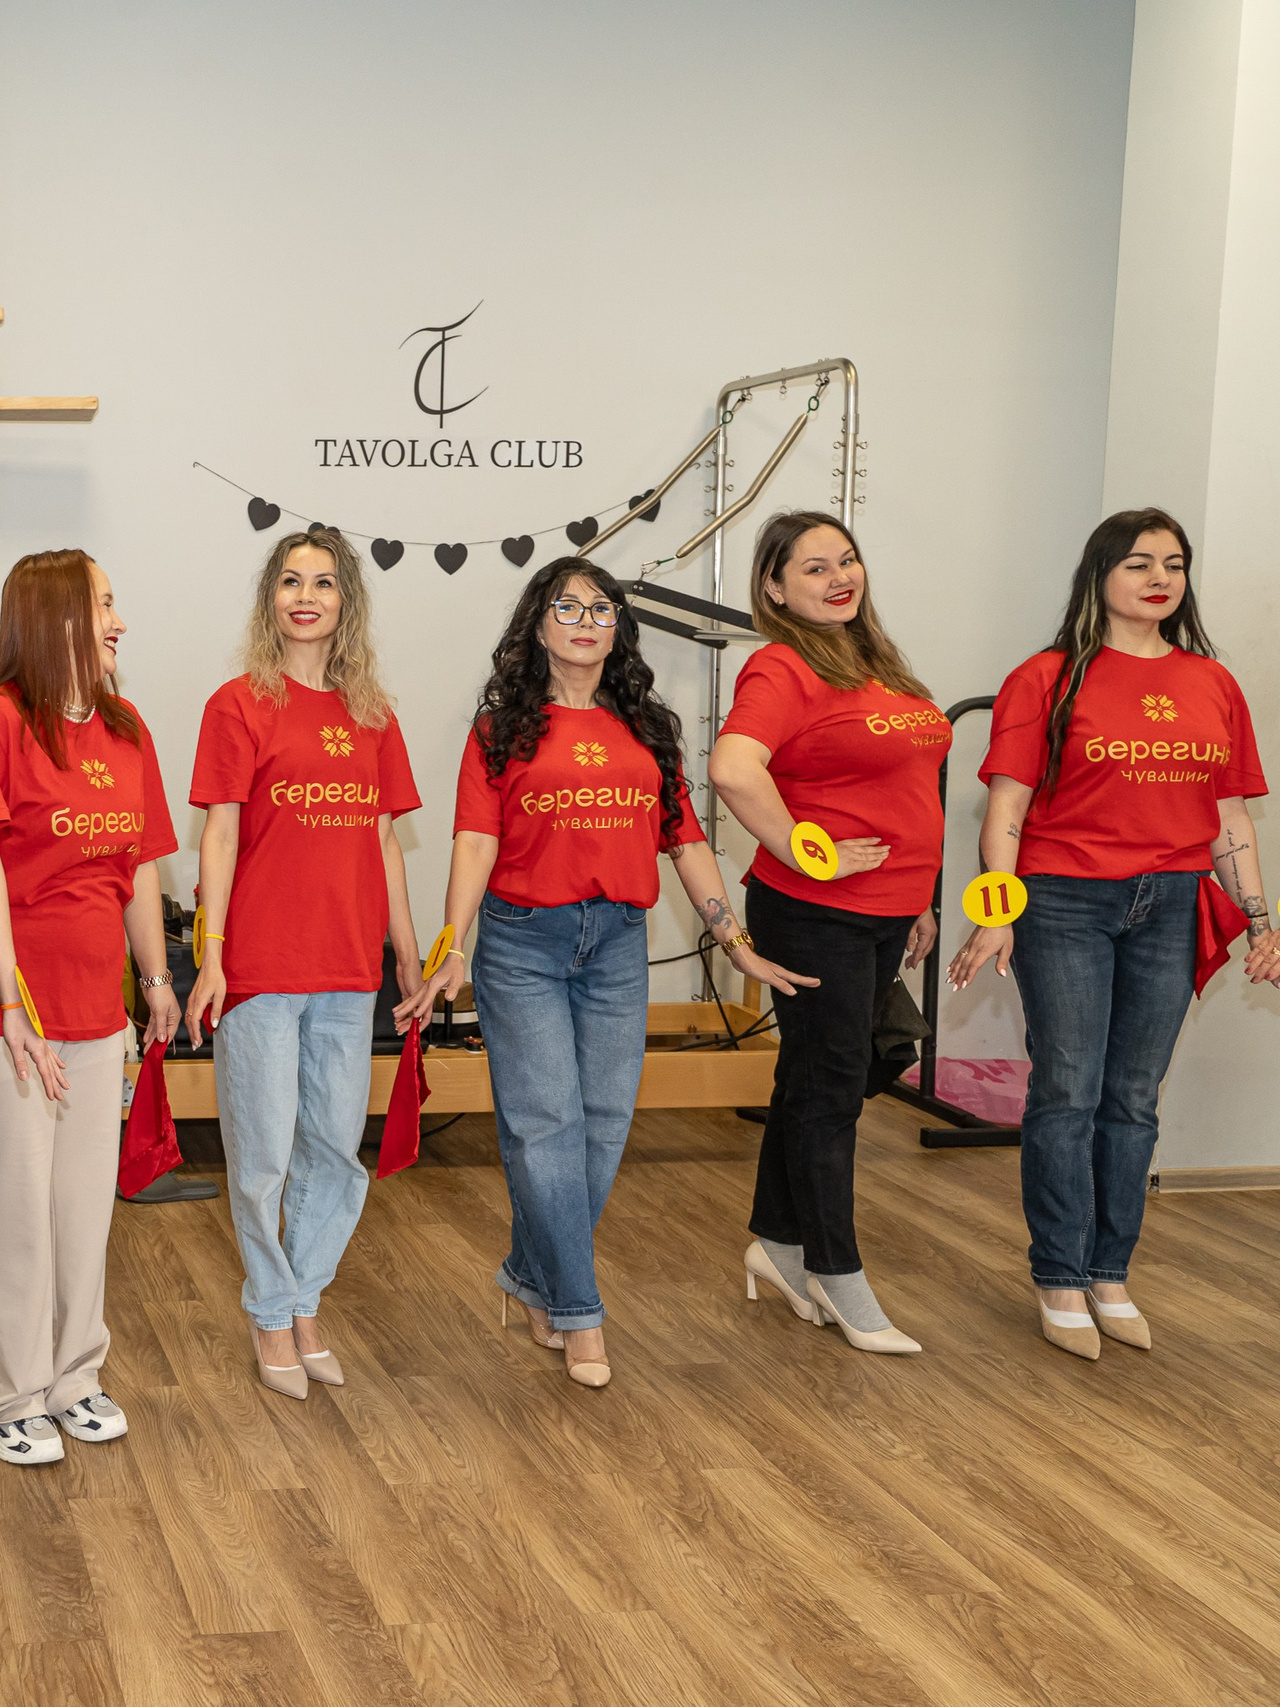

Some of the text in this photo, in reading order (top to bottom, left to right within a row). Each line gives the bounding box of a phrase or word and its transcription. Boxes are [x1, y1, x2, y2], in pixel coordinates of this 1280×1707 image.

[314, 438, 583, 468] TAVOLGA CLUB
[1120, 769, 1210, 784] чувашии
[979, 882, 1011, 917] 11
